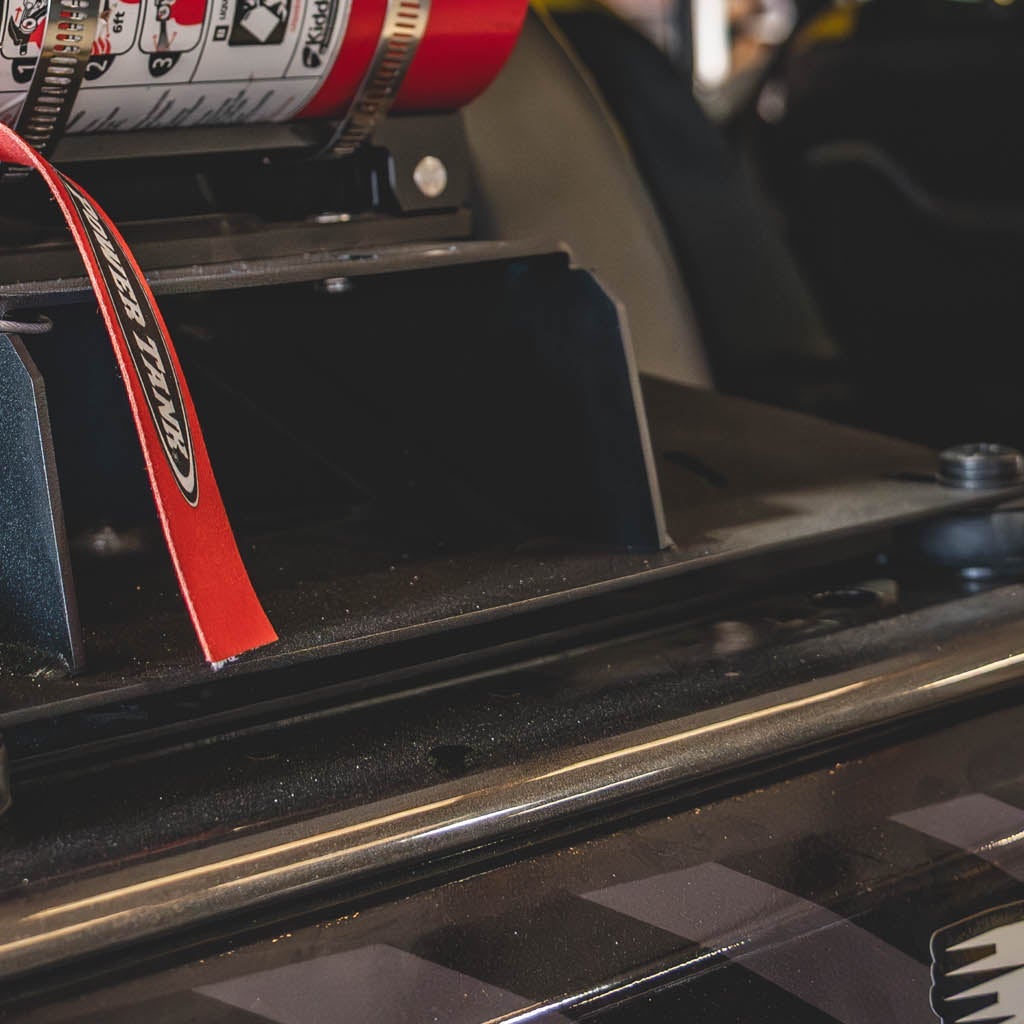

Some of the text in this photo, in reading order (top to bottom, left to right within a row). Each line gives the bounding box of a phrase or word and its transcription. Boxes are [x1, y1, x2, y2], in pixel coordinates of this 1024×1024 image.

[113, 10, 126, 34] 6ft
[86, 59, 108, 73] 2
[152, 56, 173, 70] 3
[66, 183, 189, 460] POWER TANK
